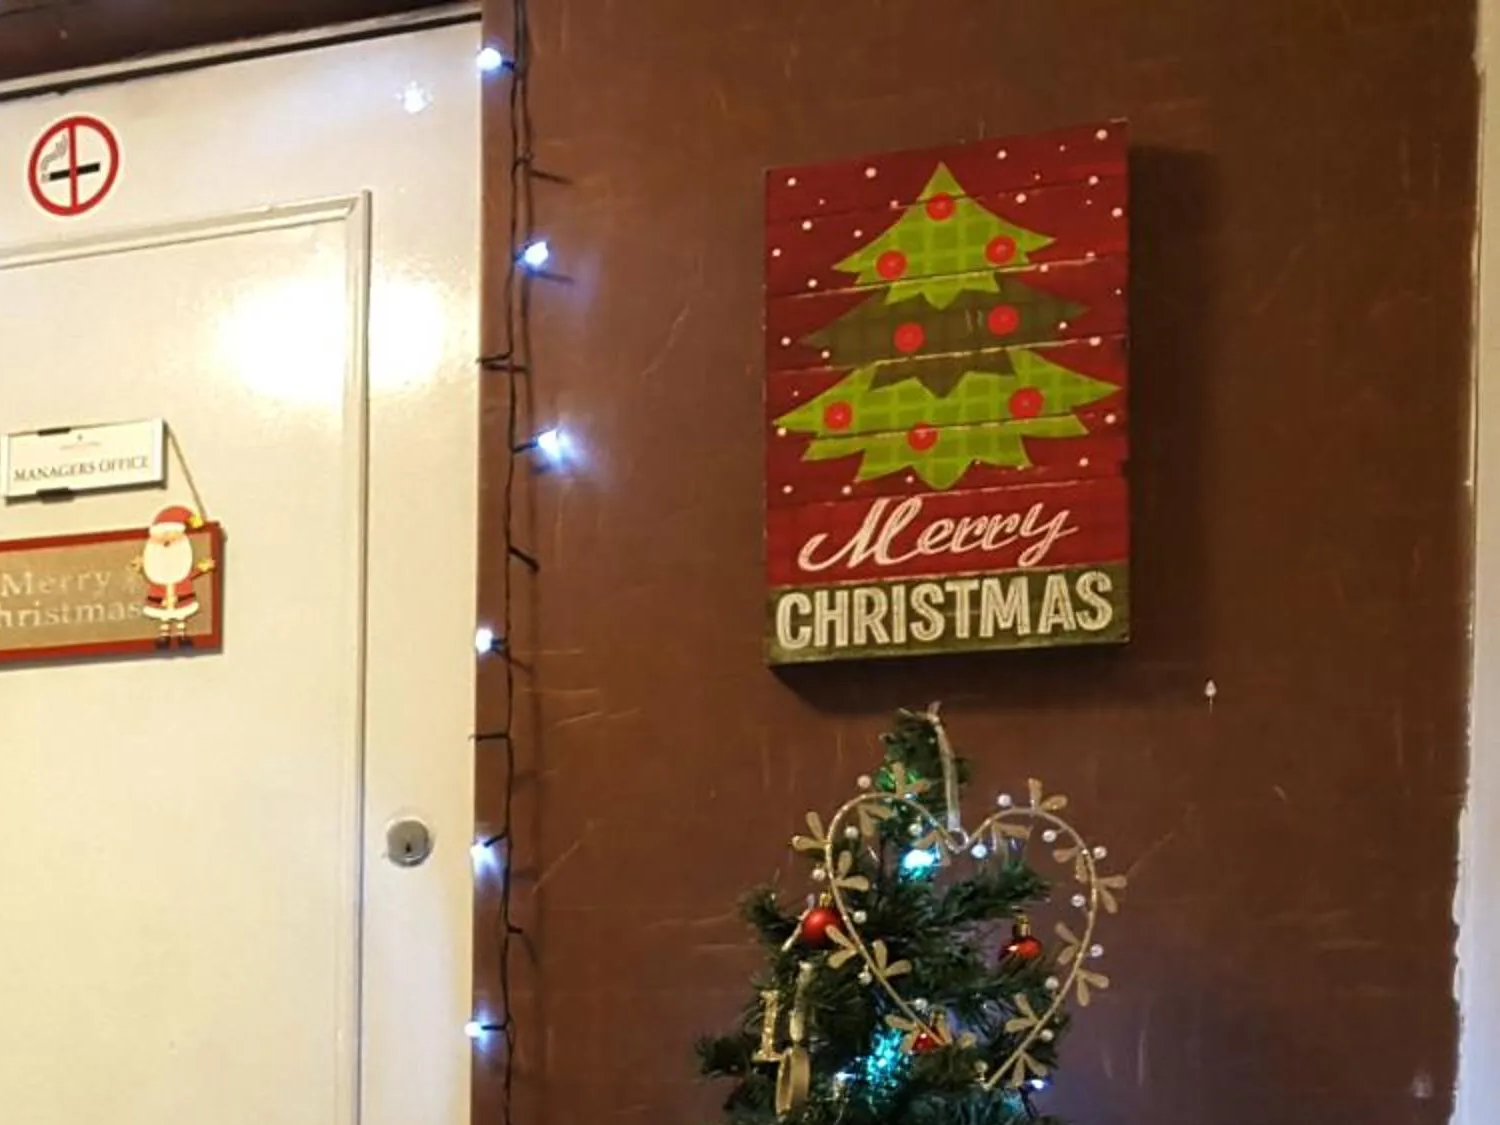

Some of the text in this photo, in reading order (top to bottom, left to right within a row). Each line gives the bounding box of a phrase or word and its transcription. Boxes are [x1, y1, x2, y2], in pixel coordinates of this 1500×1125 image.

[13, 455, 149, 482] MANAGERS OFFICE
[798, 496, 1080, 571] Merry
[0, 569, 112, 599] Merry
[775, 570, 1114, 650] CHRISTMAS
